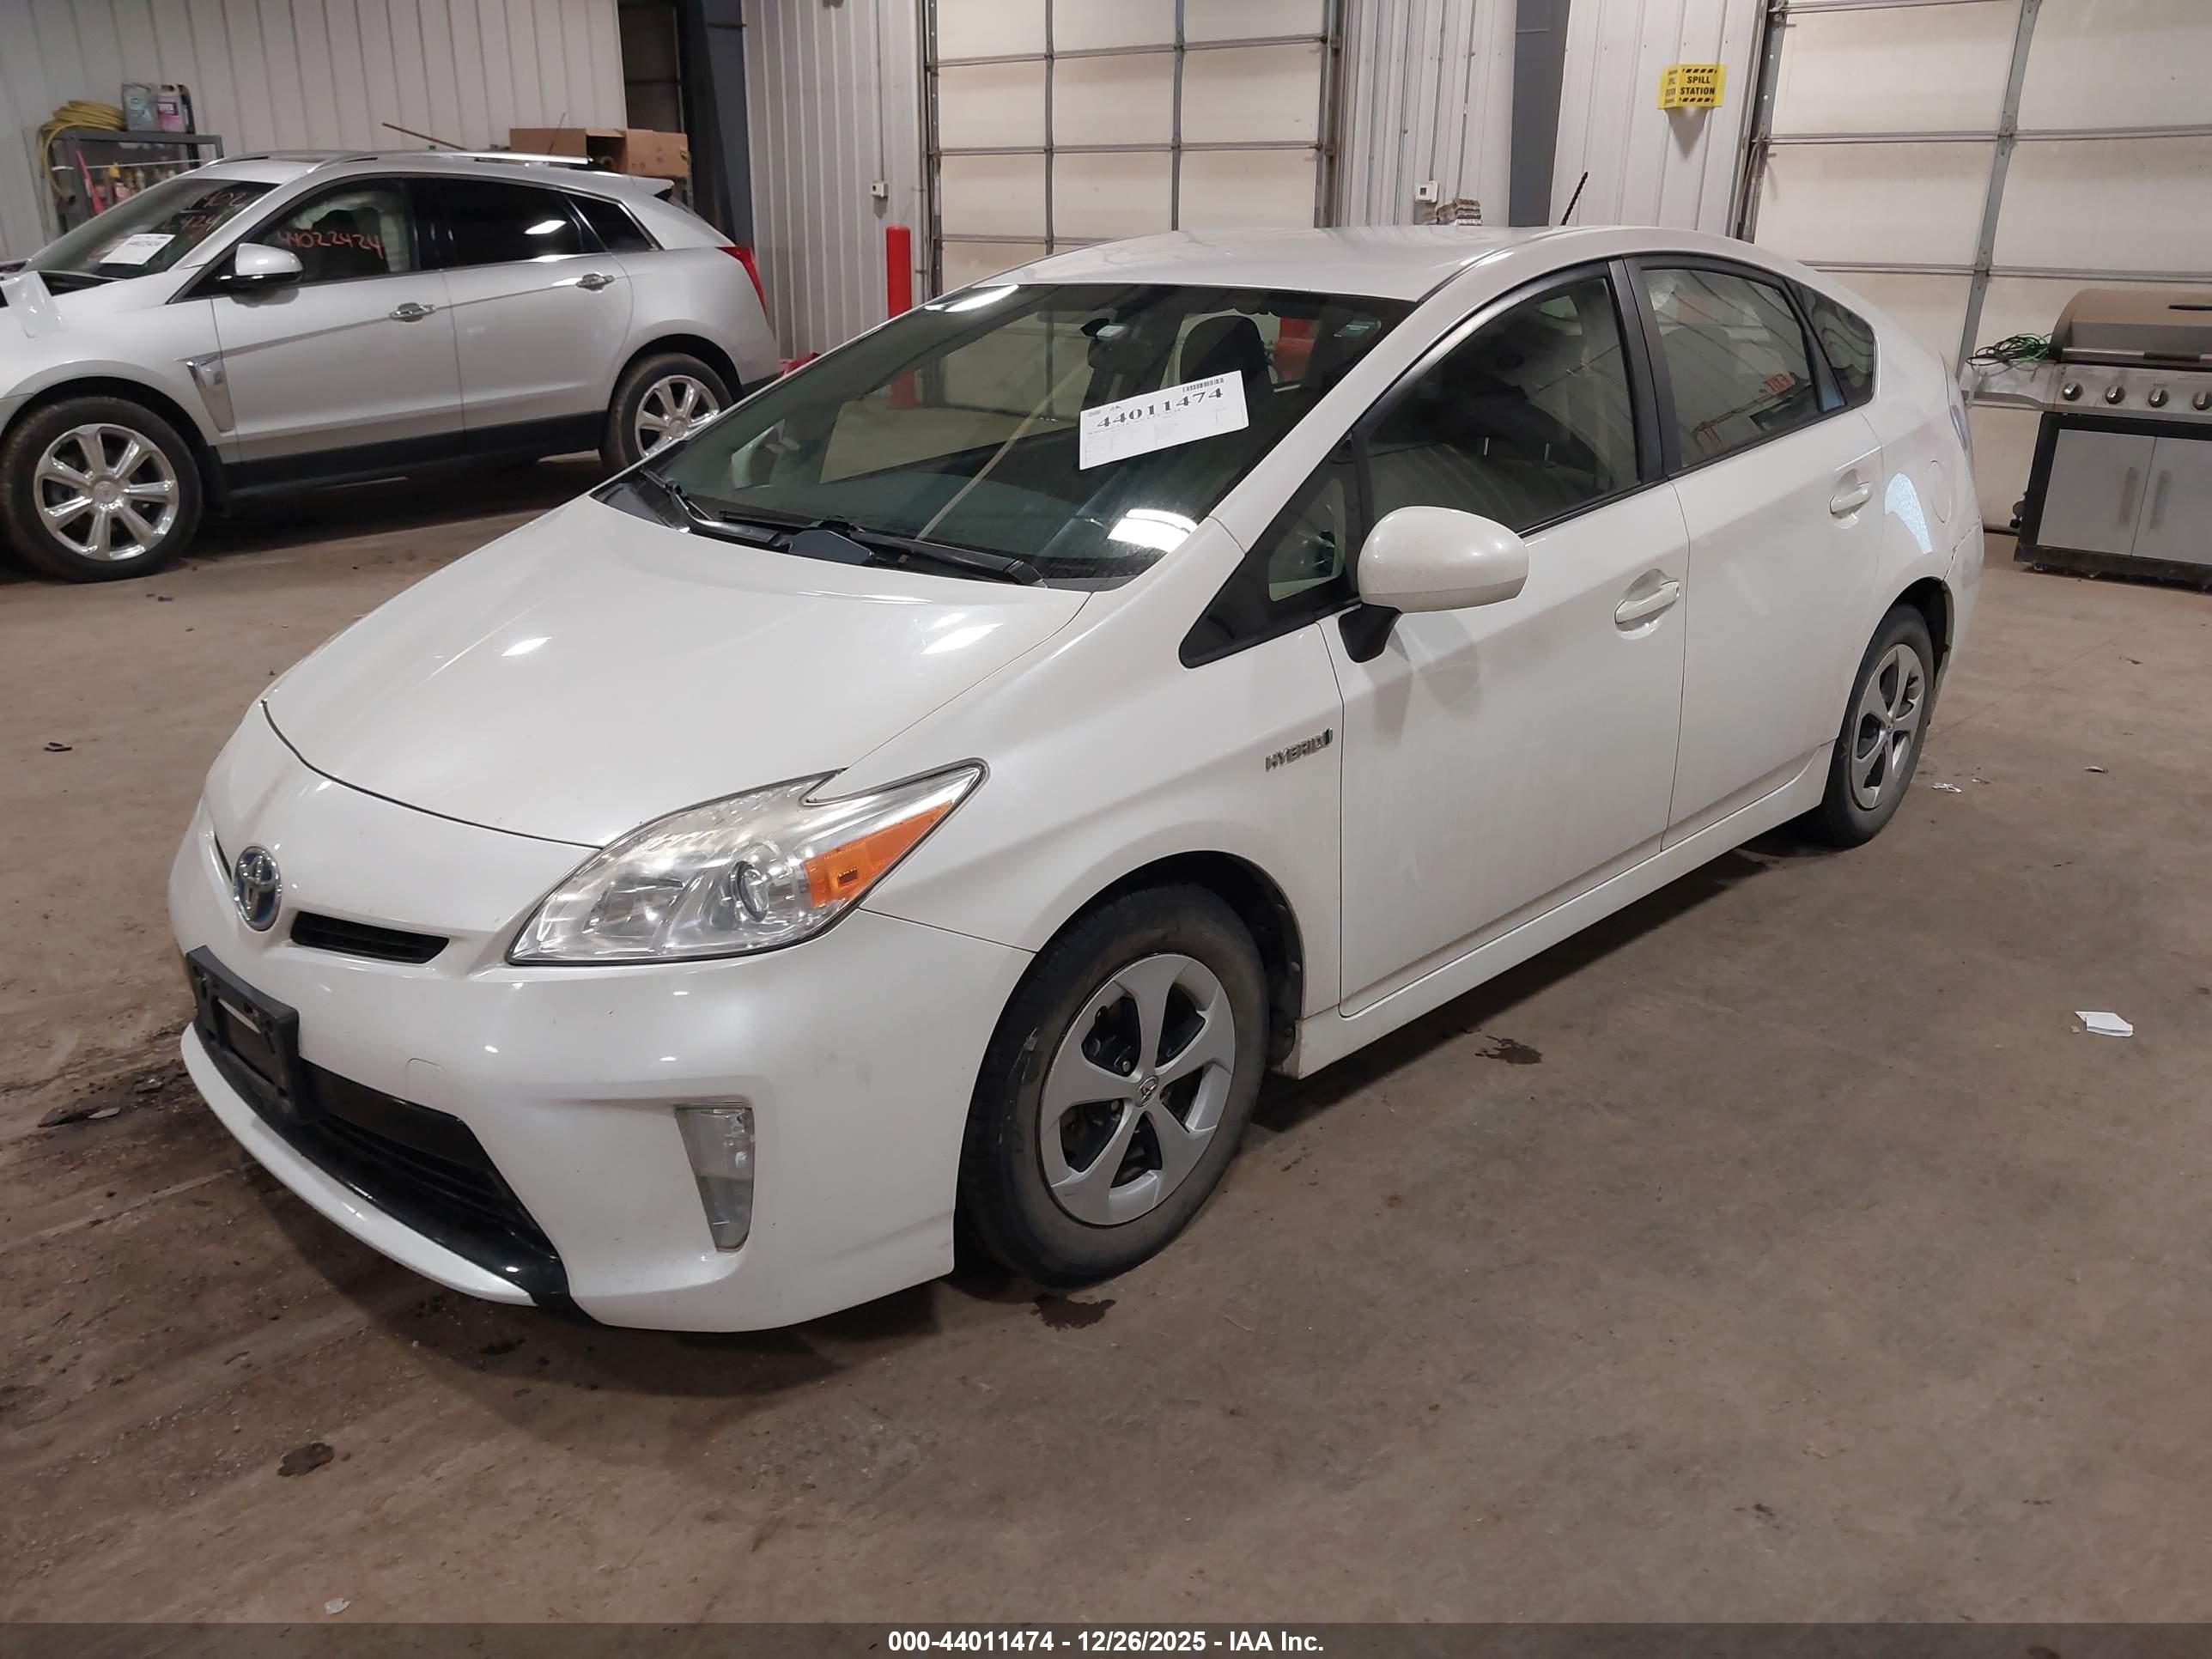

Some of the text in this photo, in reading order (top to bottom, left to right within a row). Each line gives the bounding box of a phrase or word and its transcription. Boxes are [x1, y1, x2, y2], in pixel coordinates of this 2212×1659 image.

[1680, 87, 1716, 95] STATION
[1686, 76, 1711, 84] SPILL
[276, 230, 384, 259] 44022424
[1097, 387, 1224, 428] 44011474
[1265, 736, 1322, 772] HYBRID
